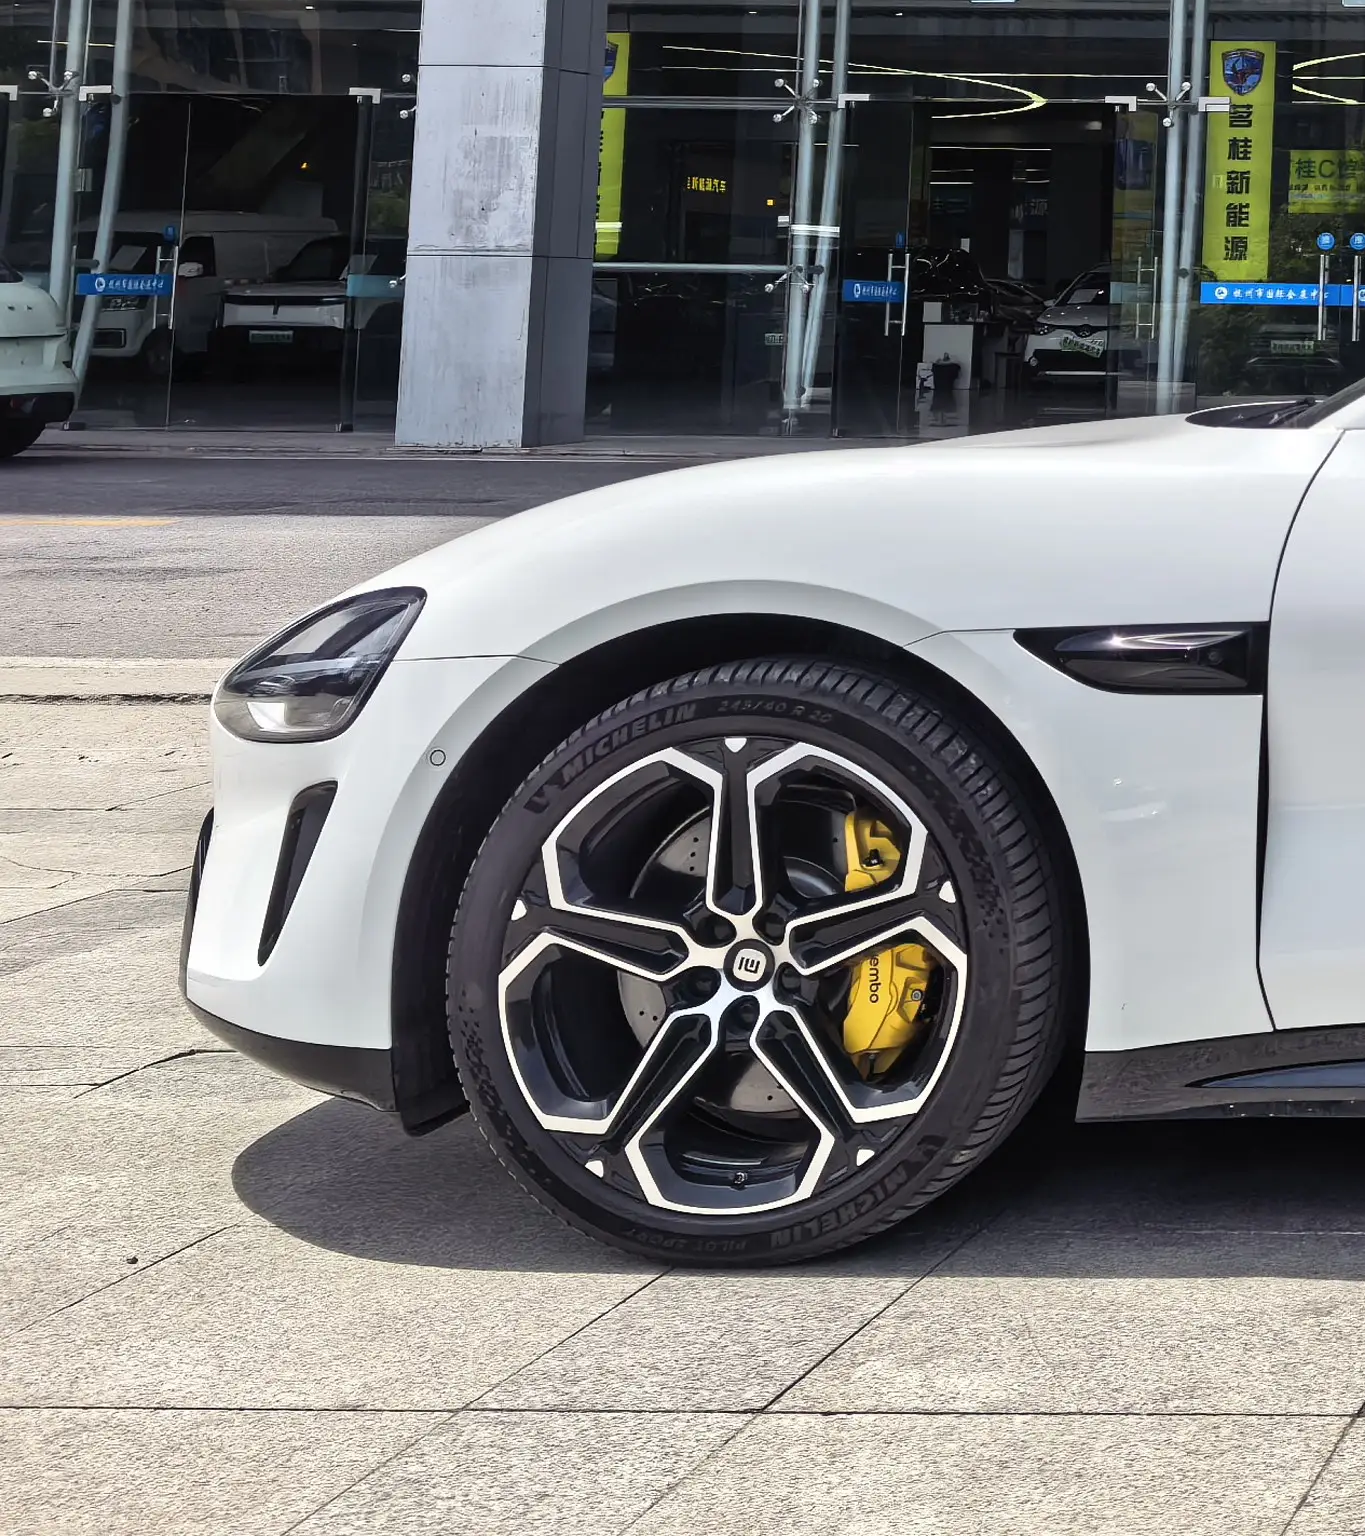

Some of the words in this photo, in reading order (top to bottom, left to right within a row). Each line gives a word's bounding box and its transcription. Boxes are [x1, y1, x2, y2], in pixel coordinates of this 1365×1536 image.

[1223, 103, 1253, 261] 茗桂新能源
[561, 702, 696, 783] MICHELIN
[869, 955, 882, 1003] embo
[770, 1166, 909, 1249] MICHELIN
